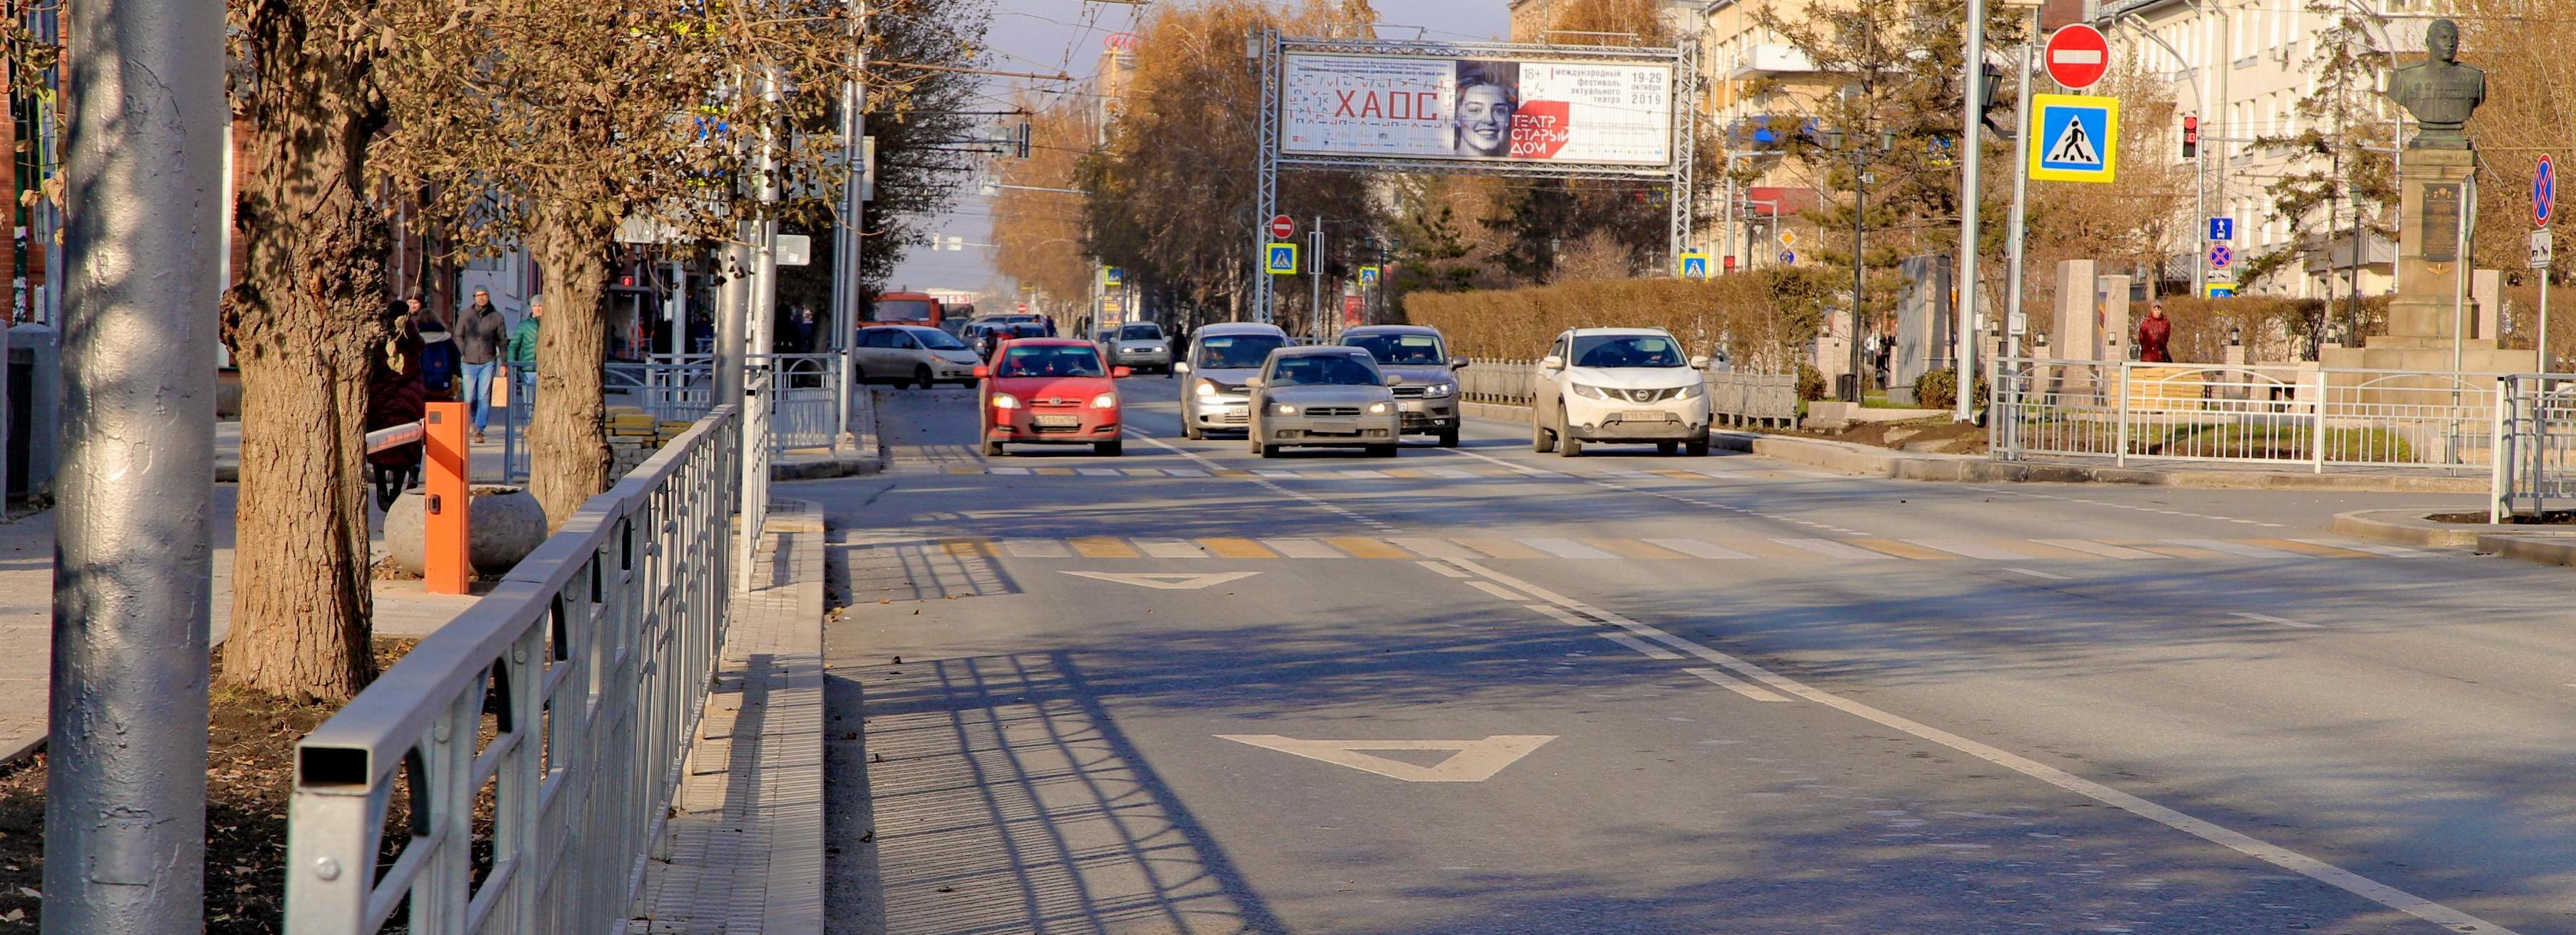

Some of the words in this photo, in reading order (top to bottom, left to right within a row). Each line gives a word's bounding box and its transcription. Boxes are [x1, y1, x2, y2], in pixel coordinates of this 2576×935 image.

[1524, 68, 1541, 80] 18+
[1555, 69, 1621, 77] международный
[1632, 72, 1662, 84] 19-29
[1577, 79, 1621, 87] фестиваль
[1571, 87, 1621, 96] актуального
[1334, 89, 1438, 121] ХАОС
[1594, 96, 1621, 104] театра
[1631, 94, 1661, 104] 2019
[1511, 114, 1557, 128] ТЕАТР
[1511, 125, 1570, 143] СТАРЫЙ
[1510, 141, 1546, 156] ДОМ
